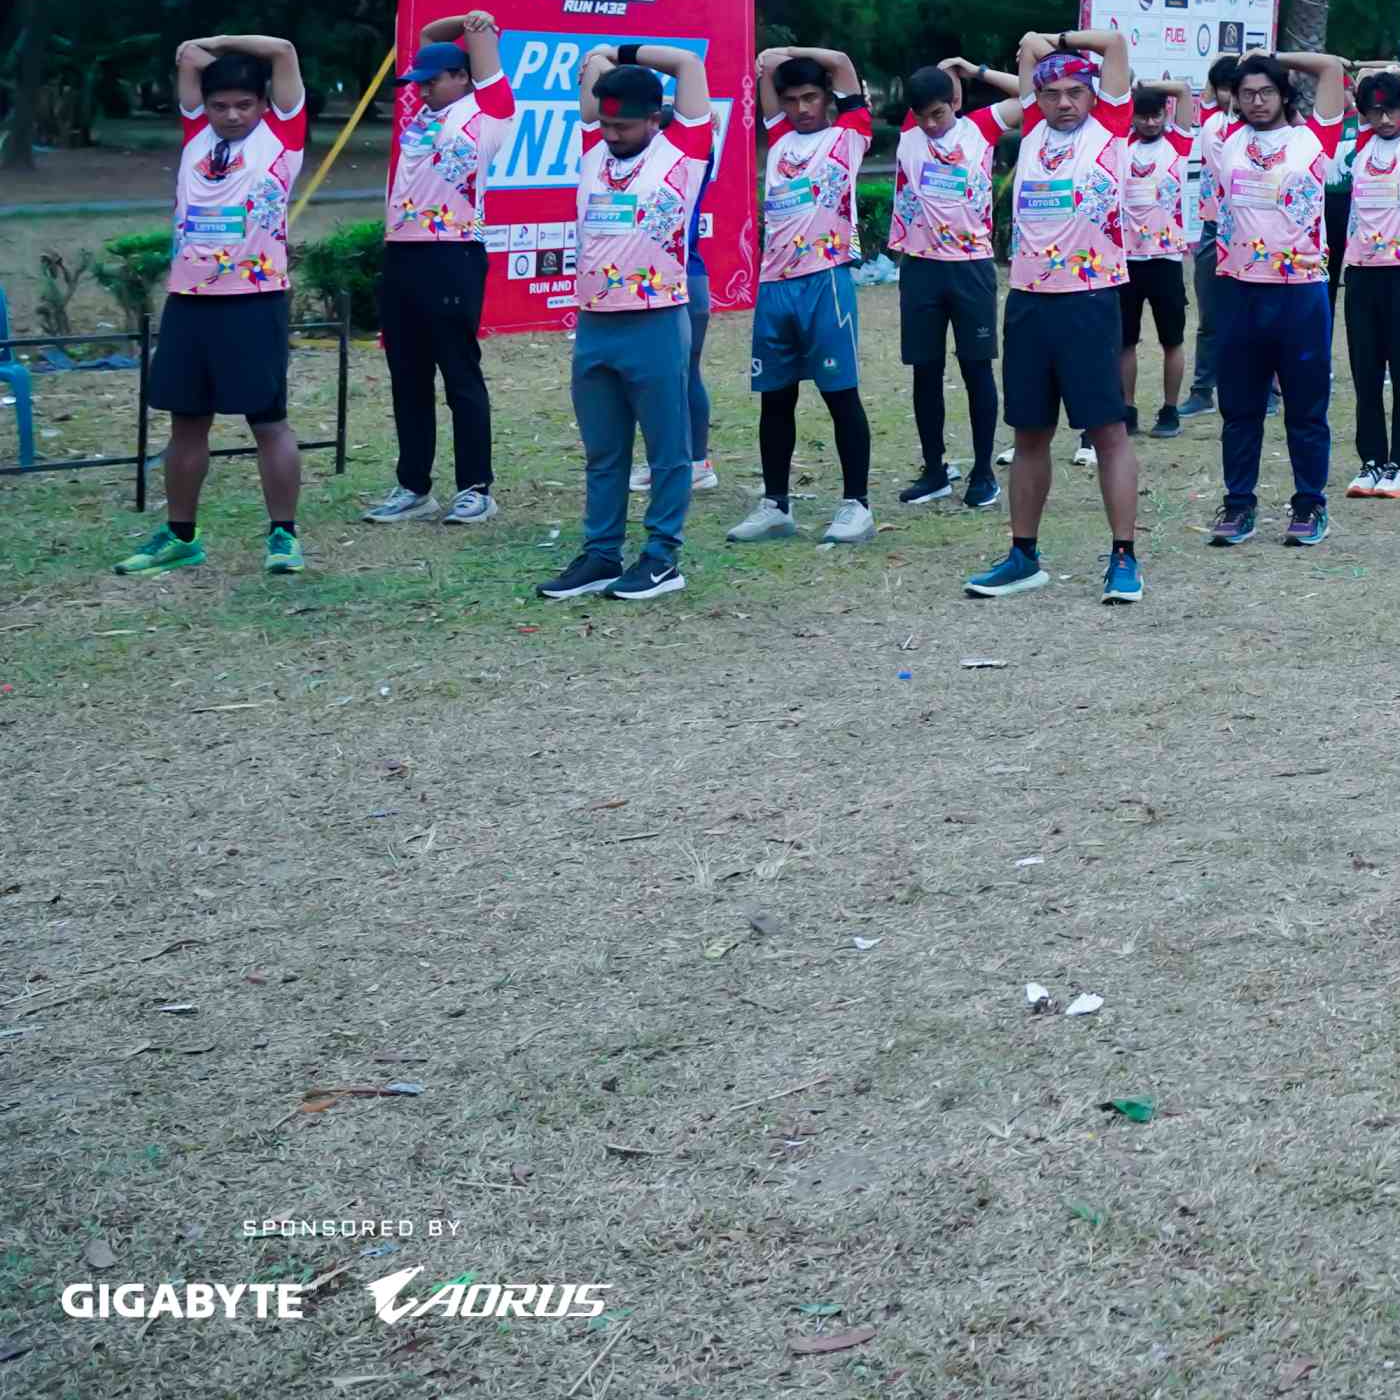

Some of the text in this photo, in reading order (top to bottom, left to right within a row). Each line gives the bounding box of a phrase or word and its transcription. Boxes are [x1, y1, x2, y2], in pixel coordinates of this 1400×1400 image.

[563, 0, 627, 16] RUN 1432
[1165, 27, 1186, 43] FUEL
[529, 280, 572, 295] RUN AND
